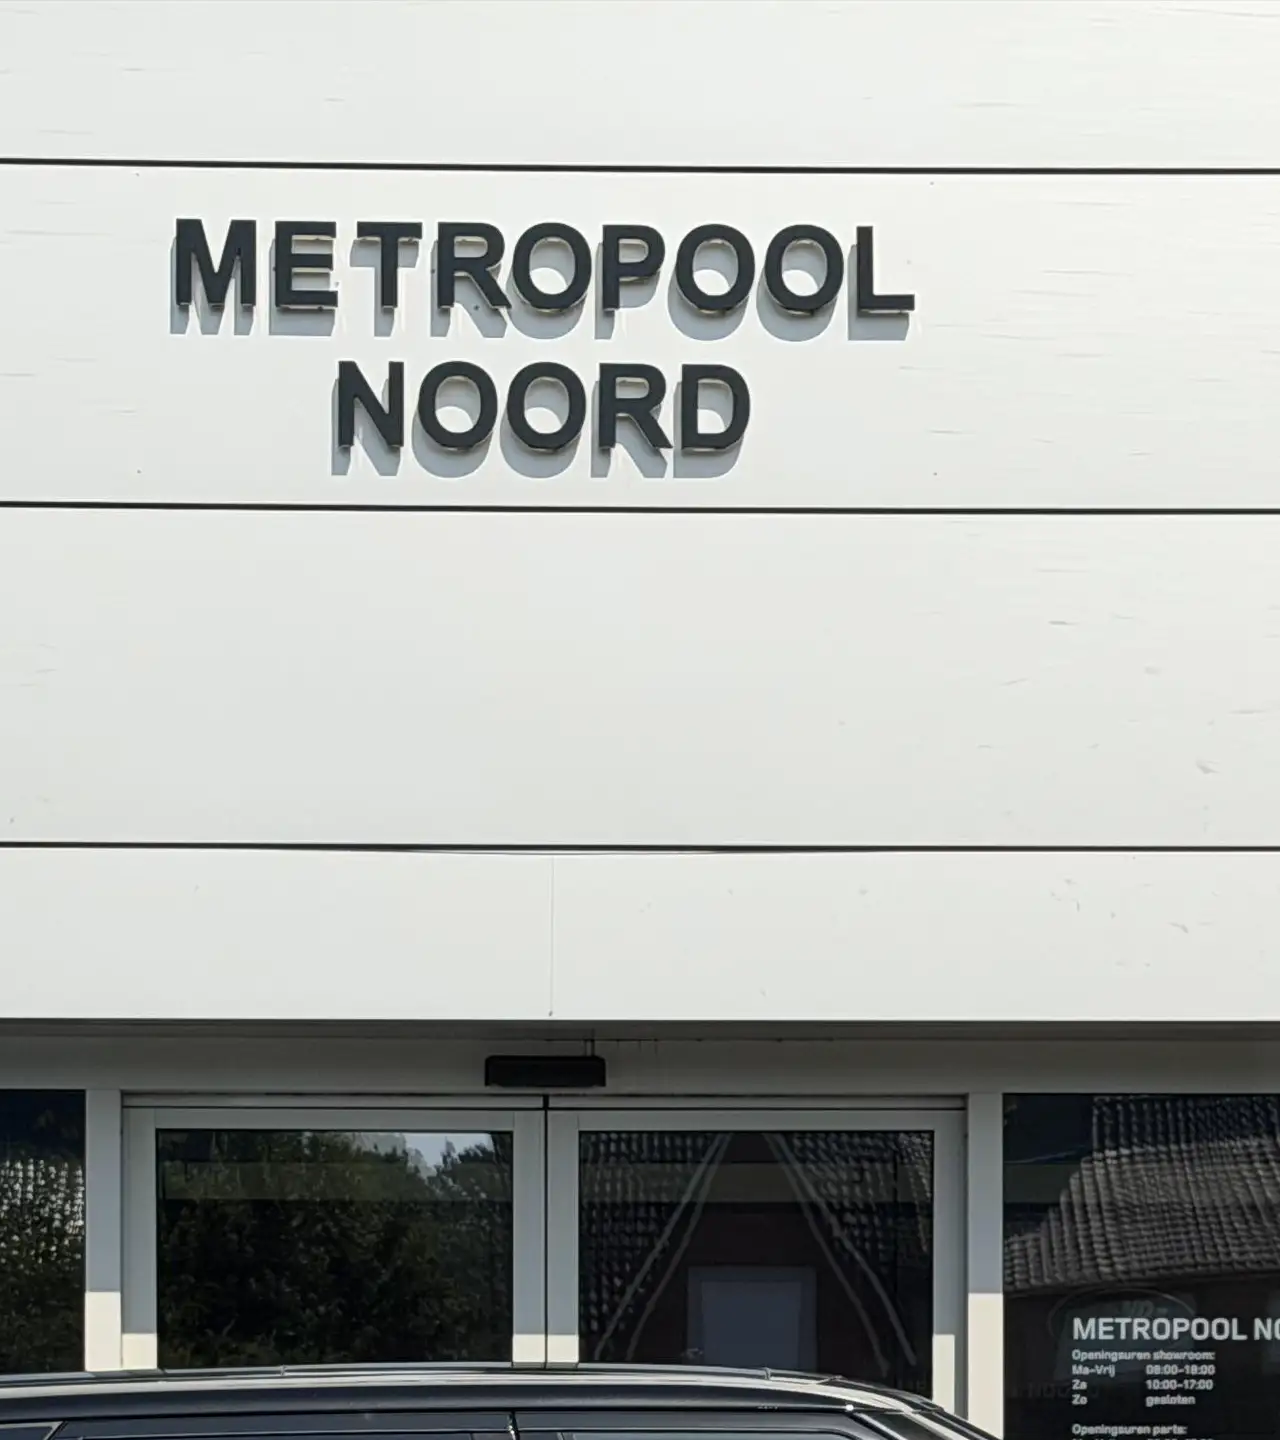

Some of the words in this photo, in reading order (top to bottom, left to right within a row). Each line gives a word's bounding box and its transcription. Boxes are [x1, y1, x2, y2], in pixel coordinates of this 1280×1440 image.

[175, 218, 916, 315] METROPOOL
[337, 360, 751, 450] NOORD
[1072, 1317, 1247, 1341] METROPOOL
[1072, 1349, 1151, 1362] Openingsuren
[1153, 1350, 1216, 1361] showroom:
[1072, 1364, 1116, 1378] Ma-Vrij
[1145, 1379, 1214, 1390] 10:00-17:00
[1145, 1394, 1196, 1407] gesloten
[1072, 1423, 1151, 1436] Openingsuren
